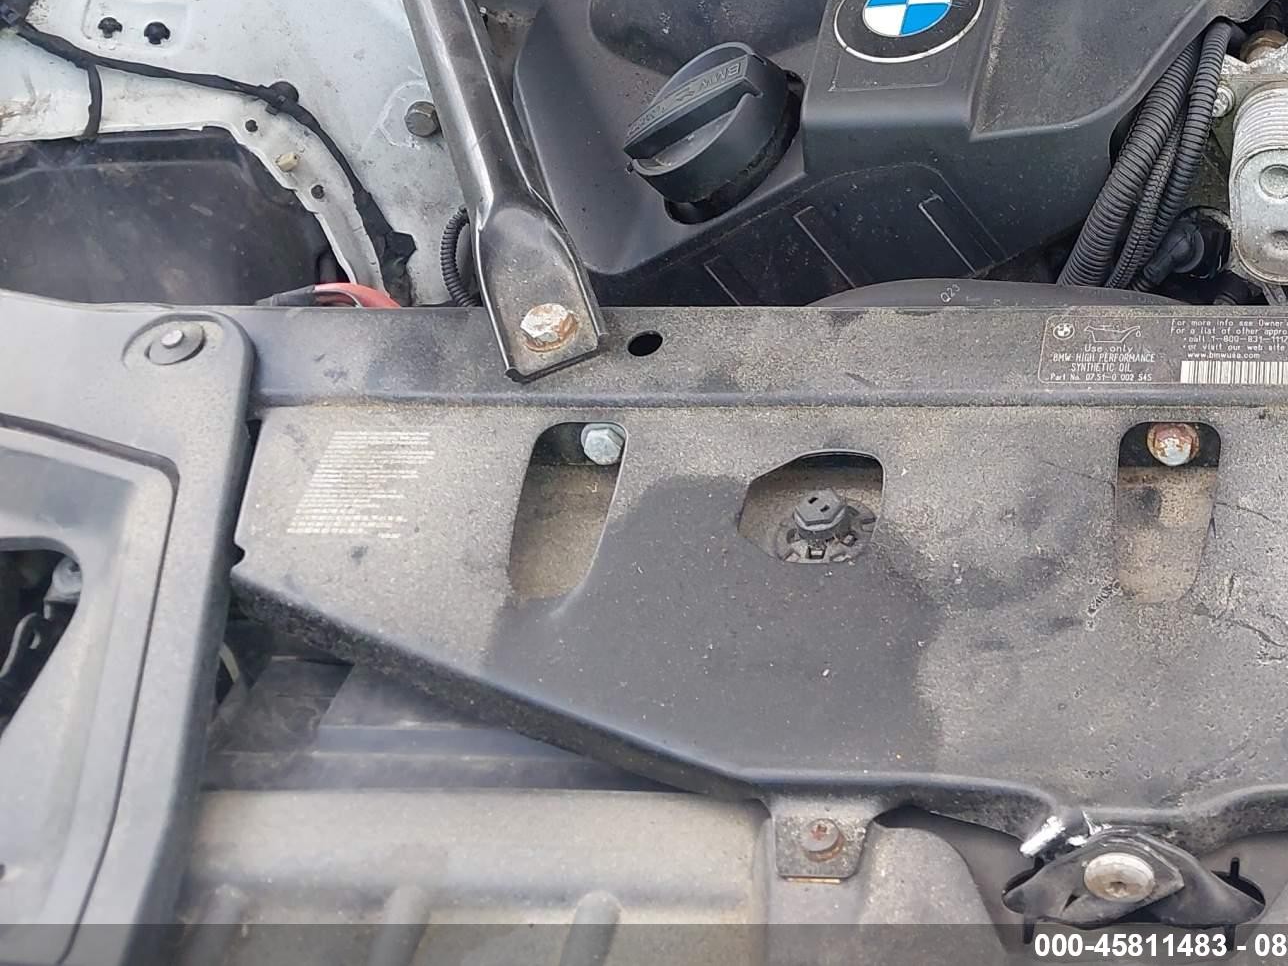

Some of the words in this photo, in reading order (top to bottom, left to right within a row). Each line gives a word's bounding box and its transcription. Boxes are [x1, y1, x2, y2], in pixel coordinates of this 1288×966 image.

[1221, 327, 1231, 335] of
[1236, 327, 1259, 335] other
[1084, 344, 1103, 353] Use
[1109, 344, 1133, 354] only
[1053, 353, 1071, 362] BMW
[1076, 353, 1095, 362] HIGH
[1099, 353, 1156, 363] PERFORMANCE
[1071, 362, 1115, 372] SYNTHETIC
[1119, 362, 1132, 372] OIL
[1050, 373, 1066, 381] Part
[1121, 374, 1135, 382] 002
